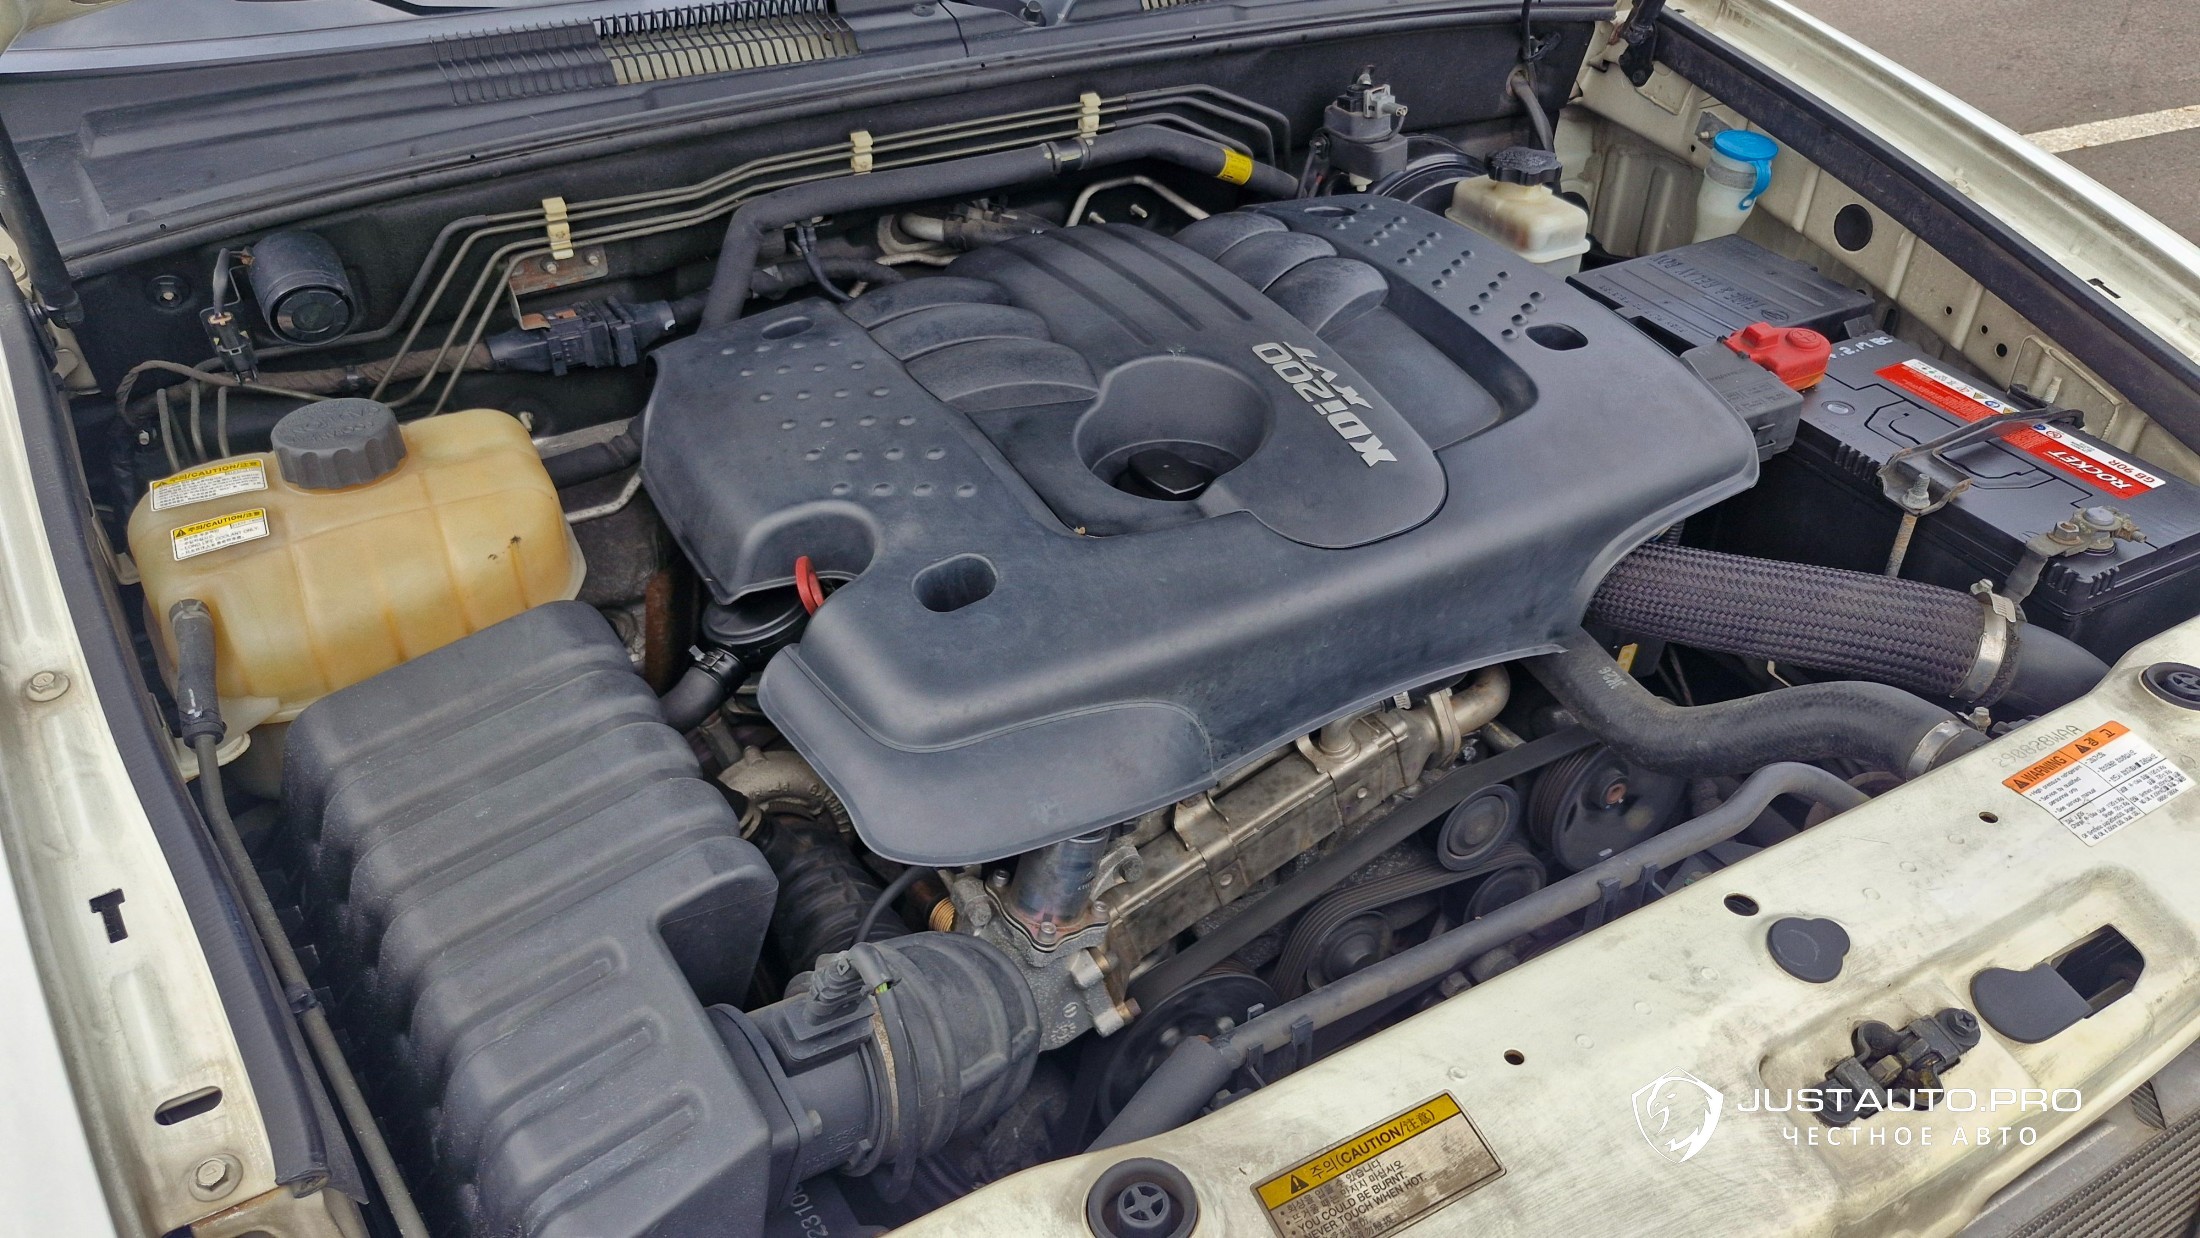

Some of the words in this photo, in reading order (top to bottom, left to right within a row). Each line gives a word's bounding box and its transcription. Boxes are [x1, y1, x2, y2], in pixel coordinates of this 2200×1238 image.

[2047, 450, 2133, 490] ROCKET
[2108, 459, 2134, 474] 90R
[2134, 472, 2156, 484] GB
[2020, 756, 2067, 782] WARNING
[1340, 1178, 1368, 1198] 만지지
[1298, 1215, 1321, 1233] YOU
[1321, 1197, 1356, 1221] COULD
[1356, 1189, 1372, 1203] BE
[1372, 1171, 1408, 1195] BURNT.
[1303, 1219, 1338, 1238] NEVER
[1337, 1200, 1373, 1224] TOUCH
[1373, 1184, 1402, 1206] WHEN
[1405, 1172, 1428, 1194] HOT.
